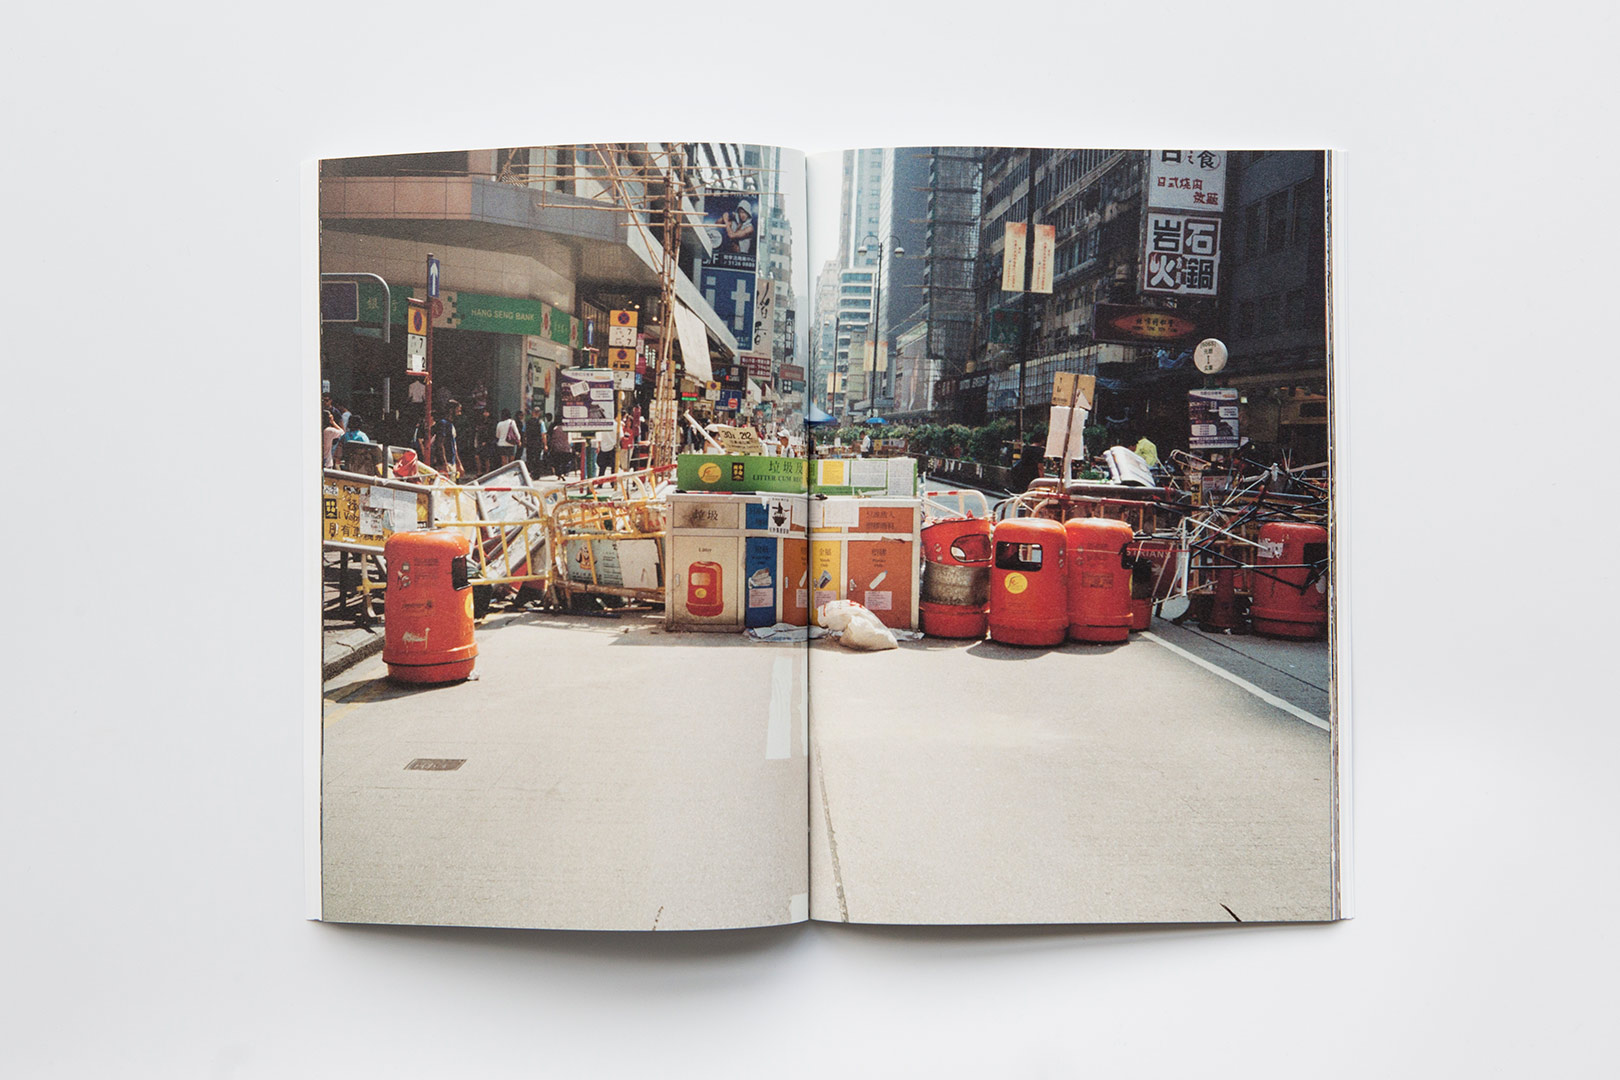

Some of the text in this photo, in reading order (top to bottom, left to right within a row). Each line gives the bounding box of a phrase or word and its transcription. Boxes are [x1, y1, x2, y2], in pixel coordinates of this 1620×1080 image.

[471, 309, 535, 321] HANG SENG BANK
